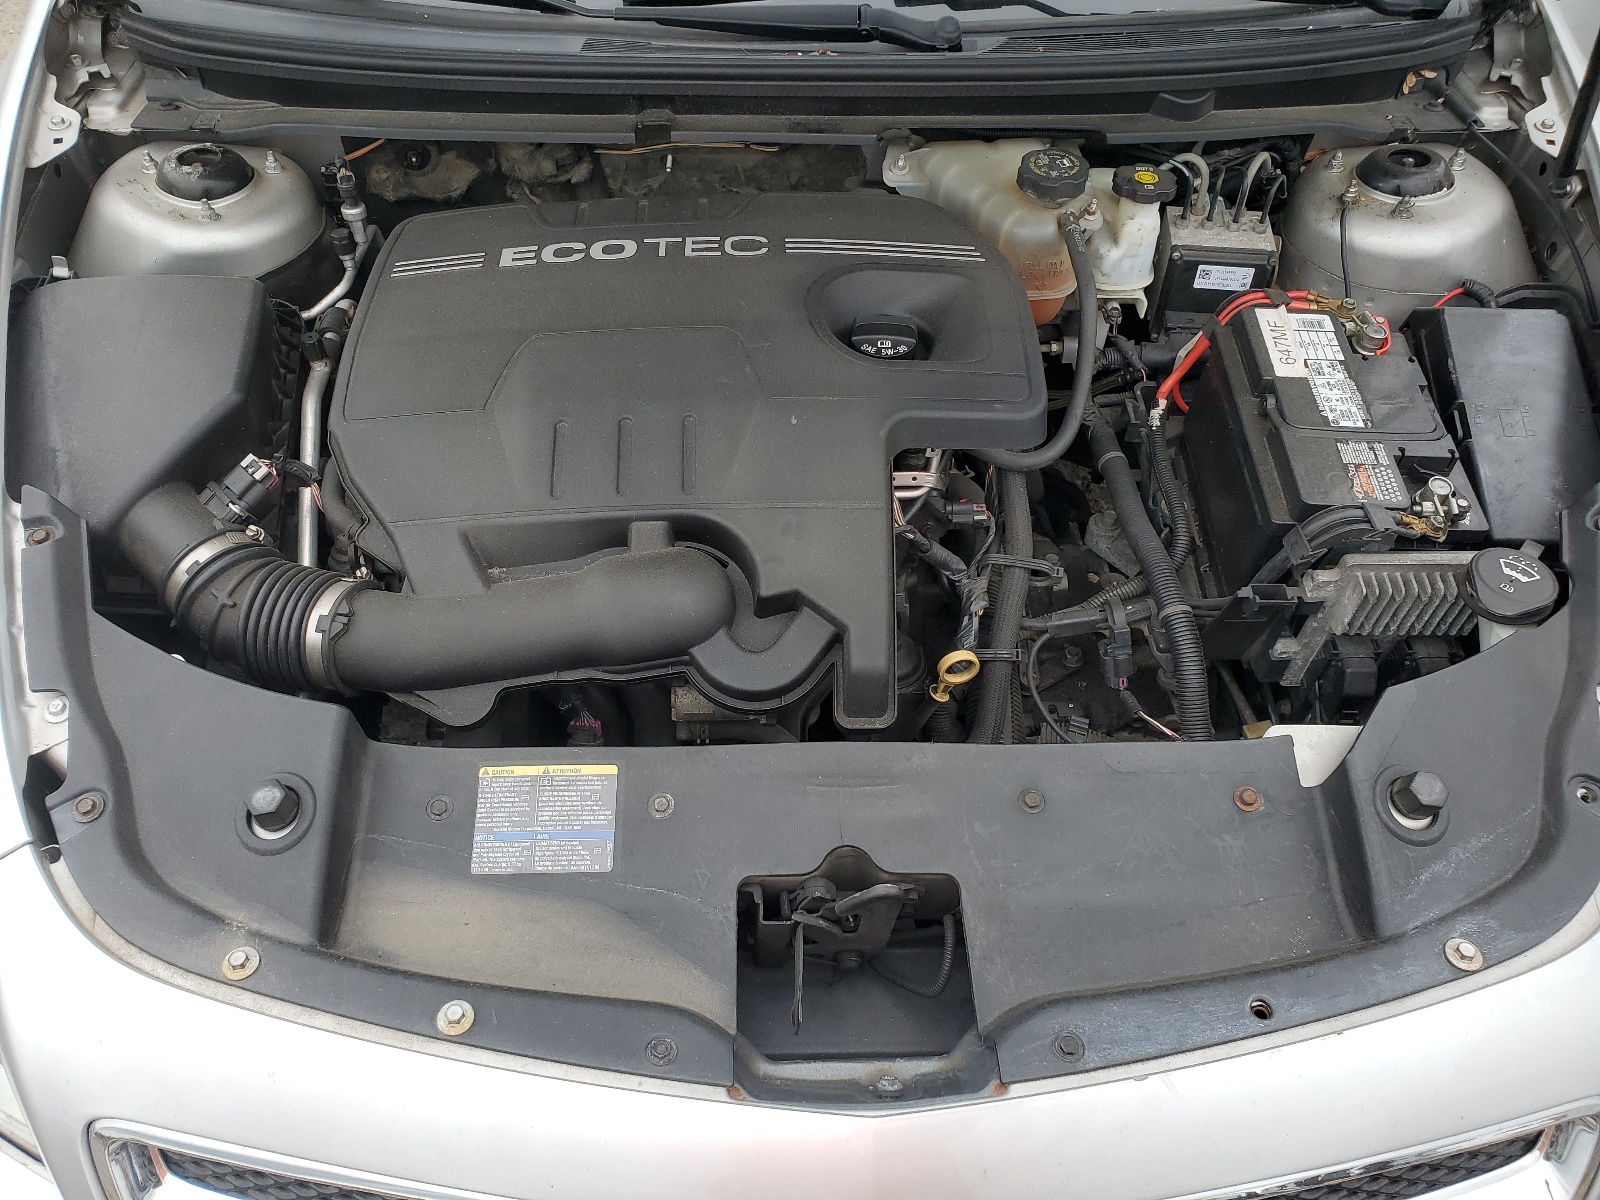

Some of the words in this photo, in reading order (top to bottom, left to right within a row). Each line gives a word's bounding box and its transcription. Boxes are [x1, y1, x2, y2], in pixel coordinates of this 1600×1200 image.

[499, 236, 769, 268] ECOTEC
[860, 344, 877, 354] SAE
[881, 345, 908, 355] 5W-30
[1266, 319, 1297, 365] 647MF
